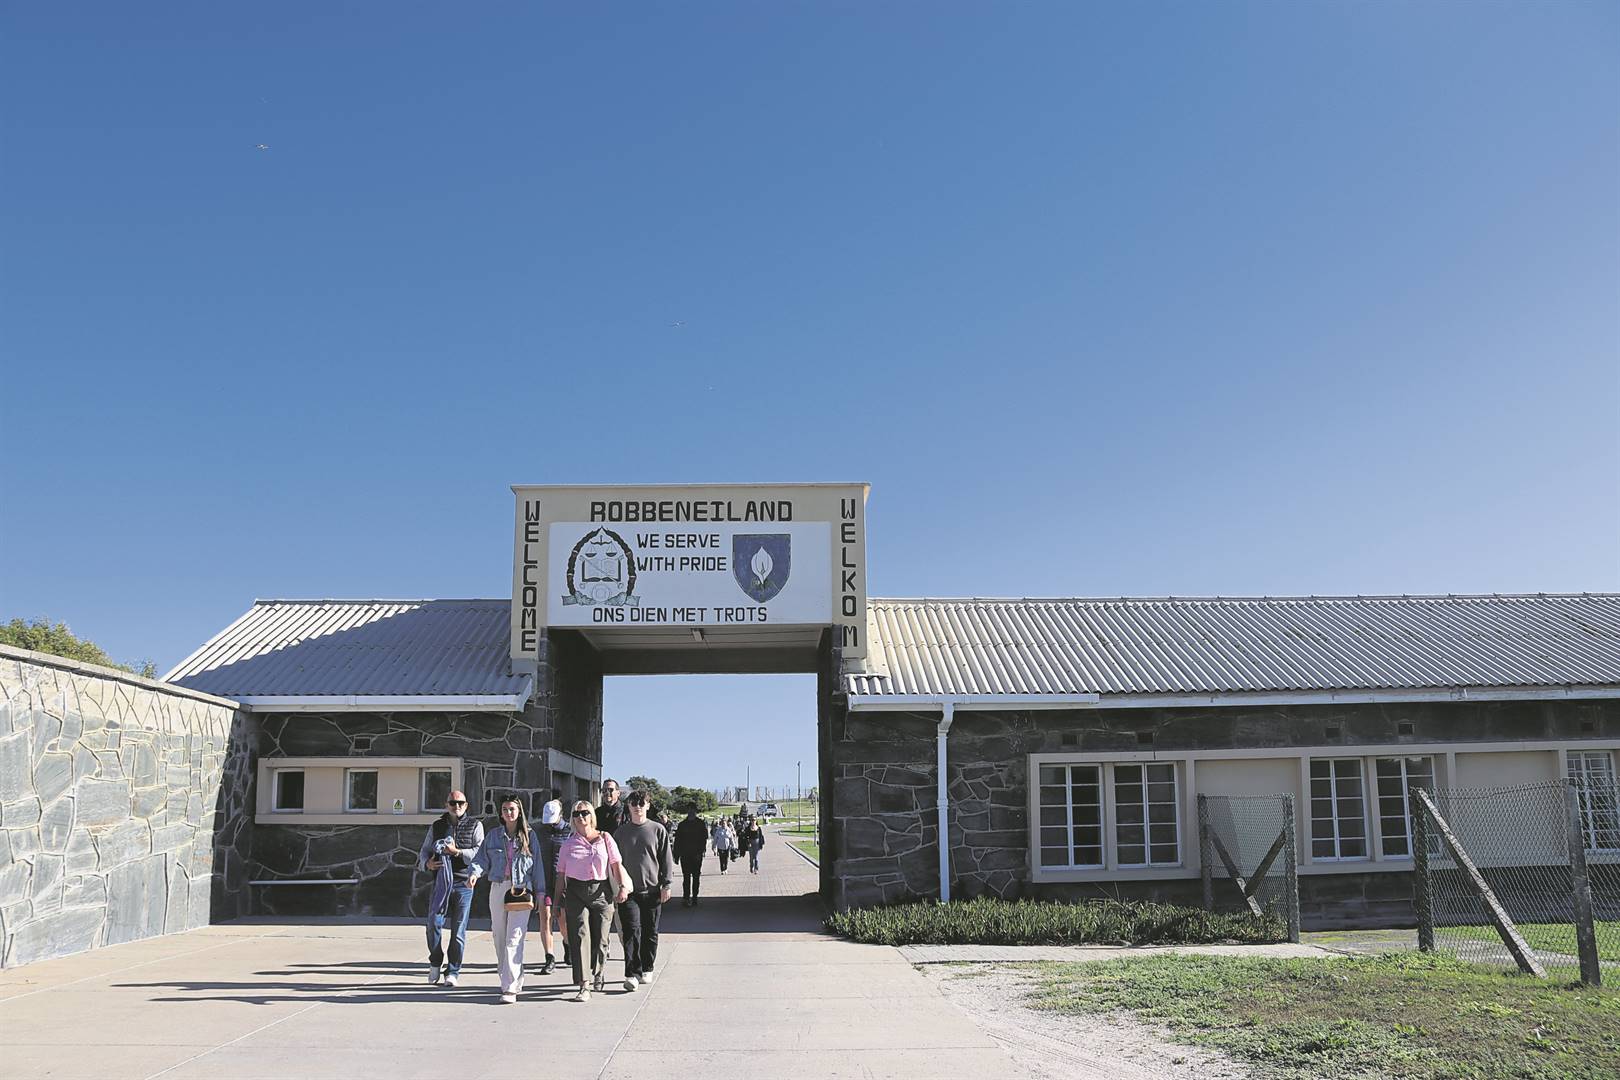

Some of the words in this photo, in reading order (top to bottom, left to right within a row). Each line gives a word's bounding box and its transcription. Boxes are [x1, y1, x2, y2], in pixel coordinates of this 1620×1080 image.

[590, 500, 793, 522] ROBBENEILAND
[636, 534, 660, 548] WE
[664, 534, 720, 548] SERVE
[636, 557, 676, 571] WITH
[679, 556, 727, 571] PRIDE
[520, 499, 541, 652] WELCOME
[840, 498, 858, 648] WELKOM
[592, 607, 625, 622] ONS
[629, 607, 669, 622] DIEN
[672, 607, 706, 622] MET
[715, 607, 768, 622] TROTS
